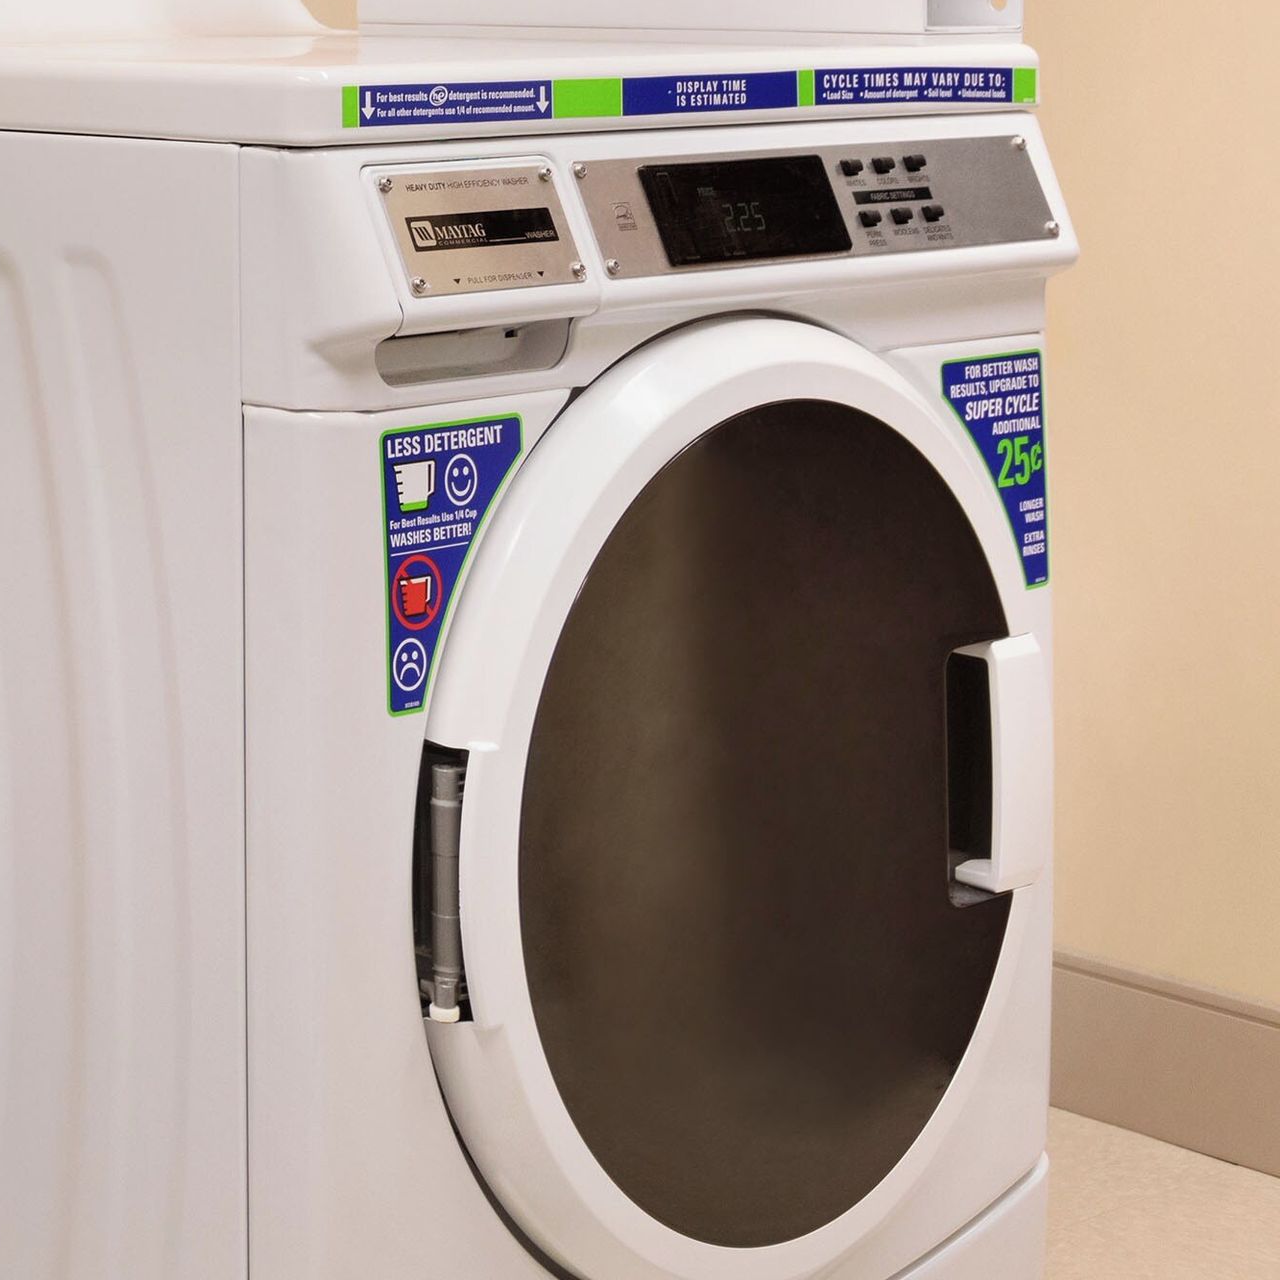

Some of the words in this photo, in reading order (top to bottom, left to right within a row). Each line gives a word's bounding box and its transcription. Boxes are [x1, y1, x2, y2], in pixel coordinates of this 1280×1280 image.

[676, 80, 720, 93] DISPLAY
[722, 80, 747, 92] TIME
[824, 74, 858, 88] CYCLE
[864, 73, 898, 87] TIMES
[904, 72, 927, 86] MAY
[932, 72, 960, 86] VARY
[964, 73, 984, 86] DUE
[988, 74, 1006, 86] TO:
[376, 92, 388, 102] For
[389, 92, 404, 102] best
[405, 91, 428, 101] results
[448, 90, 480, 102] detergent
[482, 90, 488, 99] is
[488, 88, 536, 99] recommended.
[676, 94, 688, 106] IS
[690, 93, 747, 106] ESTIMATED
[377, 108, 386, 117] For
[413, 107, 444, 118] detergents
[456, 106, 465, 115] 1/4
[405, 183, 426, 192] HEAVY
[428, 182, 446, 191] DUTY
[502, 177, 528, 186] WASHER
[722, 202, 766, 232] 2.25
[434, 223, 486, 240] MAYTAG
[525, 230, 555, 239] WASHER
[965, 365, 980, 380] FOR
[982, 362, 1012, 378] BETTER
[1014, 358, 1038, 372] WASH
[950, 382, 988, 398] RESULTS,
[989, 376, 1026, 393] UPGRADE
[1028, 374, 1038, 388] TO
[965, 398, 1002, 420] SUPER
[1005, 392, 1040, 415] CYCLE
[992, 416, 1041, 436] ADDITIONAL
[387, 435, 420, 458] LESS
[424, 425, 502, 452] DETERGENT
[997, 436, 1042, 488] 25¢
[390, 520, 400, 530] For
[402, 518, 416, 528] Best
[417, 516, 440, 526] Results
[442, 512, 453, 522] Use
[454, 510, 464, 520] 1/4
[464, 509, 478, 520] Cup
[390, 529, 431, 548] WASHES
[434, 522, 472, 540] BETTER!
[1024, 530, 1044, 544] EXTRA
